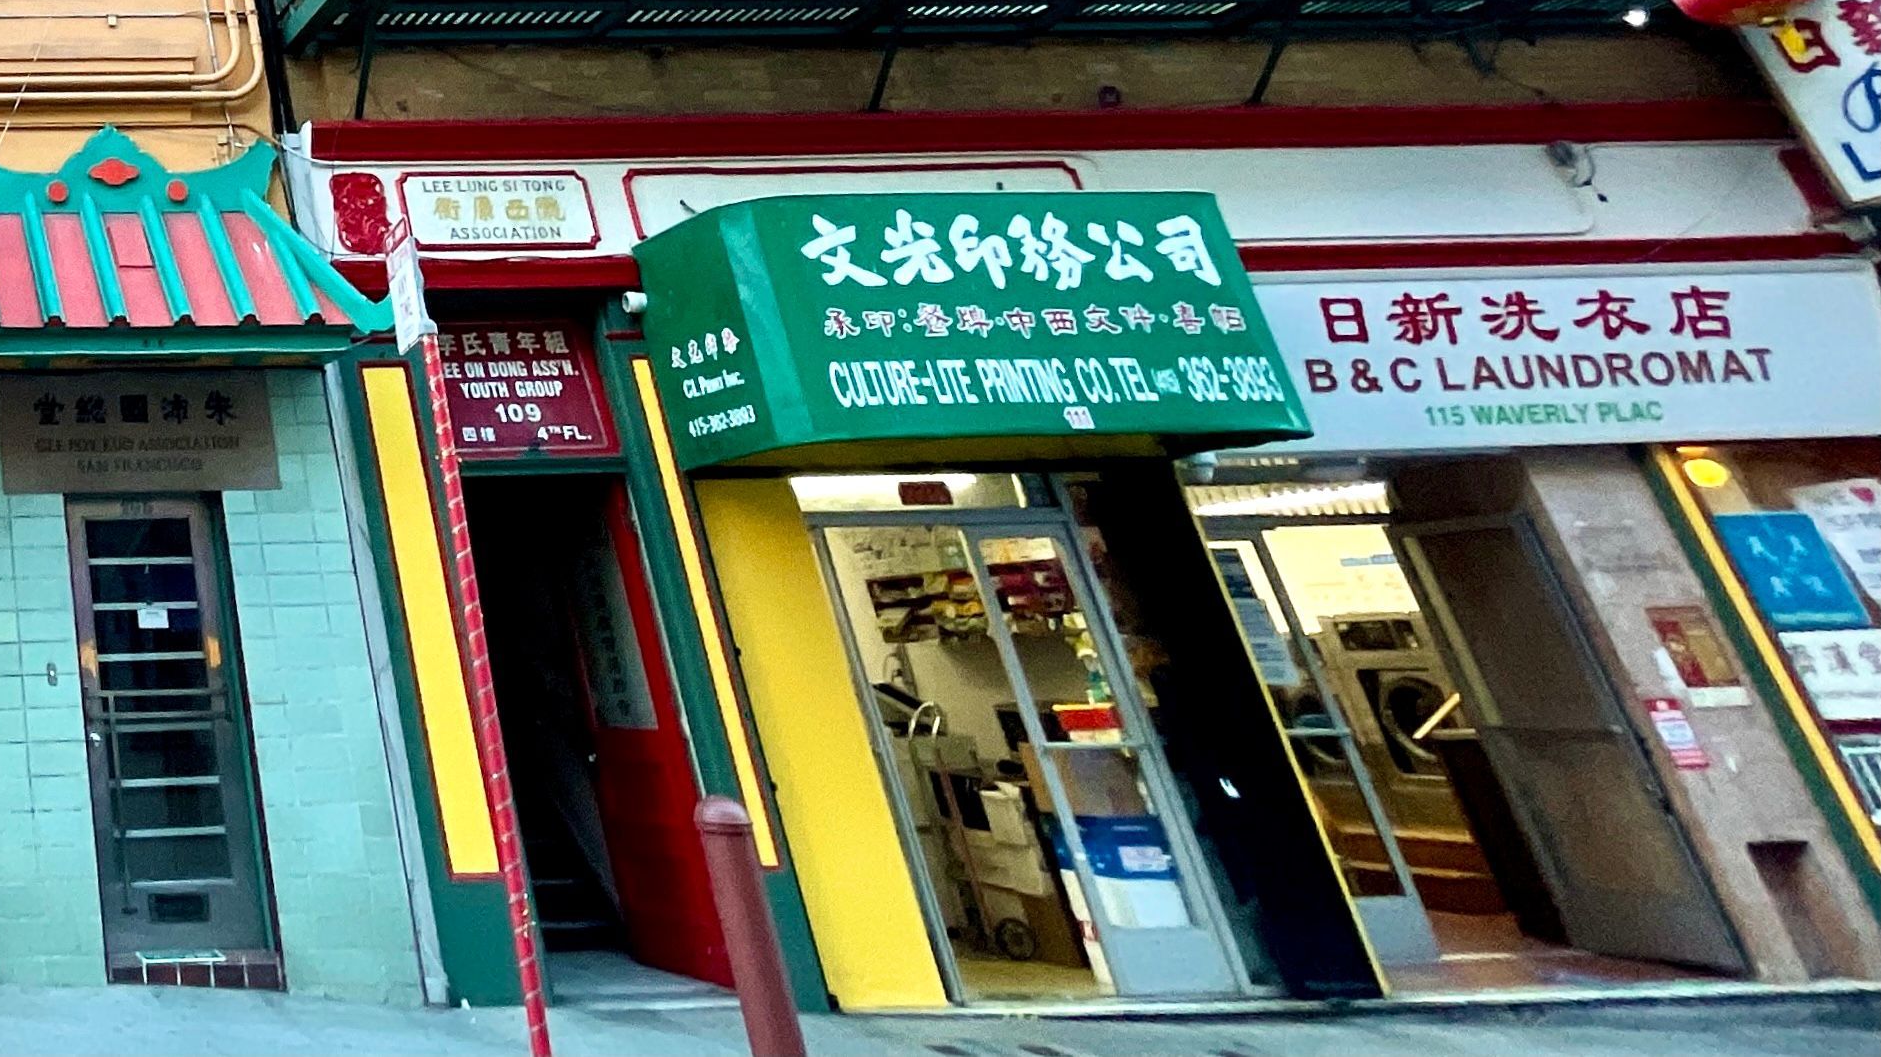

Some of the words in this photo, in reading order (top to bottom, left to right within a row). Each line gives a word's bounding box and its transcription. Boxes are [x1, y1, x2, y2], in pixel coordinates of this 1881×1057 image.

[422, 180, 453, 193] LEE
[457, 180, 498, 192] LUNG
[502, 181, 519, 192] SI
[522, 180, 566, 192] TONG
[450, 226, 562, 240] ASSOCIATION
[800, 208, 1222, 291] 文光印務公司
[1319, 286, 1733, 346] 日新洗衣店
[443, 362, 462, 379] EE
[464, 362, 485, 378] ON
[488, 361, 528, 378] DONG
[532, 359, 580, 377] ASS'N.
[1305, 358, 1339, 394] B
[1350, 358, 1383, 395] &
[1390, 357, 1423, 393] C
[1439, 348, 1775, 392] LAUNDROMAT
[459, 382, 510, 399] YOUTH
[514, 380, 563, 398] GROUP
[828, 358, 980, 408] CULTURE-LITE
[975, 357, 1077, 404] PRINTING
[1177, 355, 1286, 403] 362-3893
[494, 402, 542, 423] 109
[1063, 406, 1096, 429] 111
[1424, 405, 1466, 427] 115
[1470, 402, 1590, 426] WAVERLY
[1595, 400, 1664, 423] PLAC
